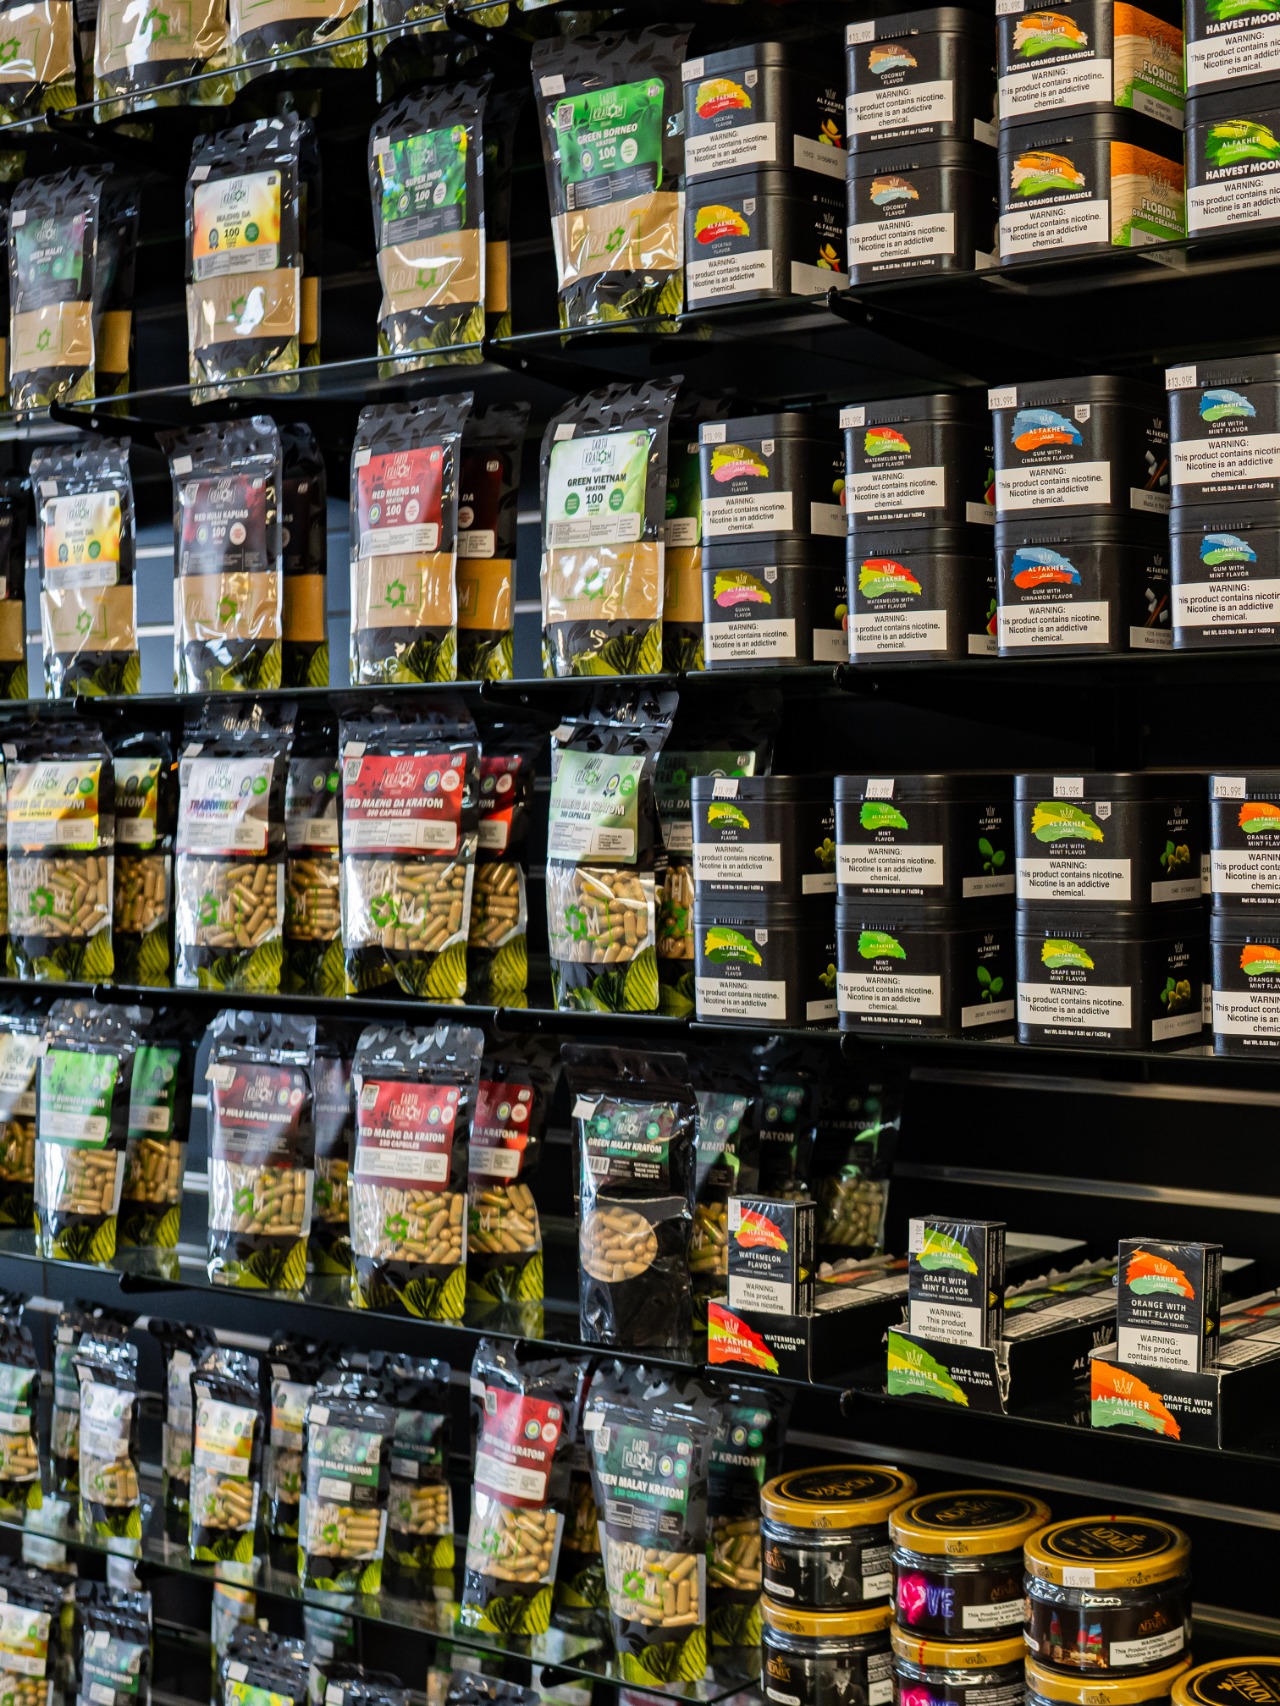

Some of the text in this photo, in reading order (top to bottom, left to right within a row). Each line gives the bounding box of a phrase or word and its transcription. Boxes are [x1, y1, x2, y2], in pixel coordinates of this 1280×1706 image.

[1206, 18, 1249, 34] HARVEST
[1006, 50, 1094, 72] FLORIDA ORANGE CREAMSICLE
[599, 146, 616, 160] 100
[1206, 164, 1249, 180] HARVEST
[568, 473, 626, 487] GREEN VIETNAM
[586, 493, 603, 504] 100
[386, 504, 400, 516] 100
[924, 1275, 946, 1283] GRAPE
[922, 1284, 969, 1295] MINT FLAVOR
[723, 1337, 752, 1348] FAKHER
[764, 1335, 805, 1345] WATERMELON
[774, 1342, 796, 1351] FLAVOR
[905, 1369, 938, 1381] FAKHER
[1097, 1395, 1149, 1410] AL FAKHER
[1163, 1395, 1213, 1407] ORANGE WITH
[1165, 1403, 1212, 1415] MINT FLAVOR
